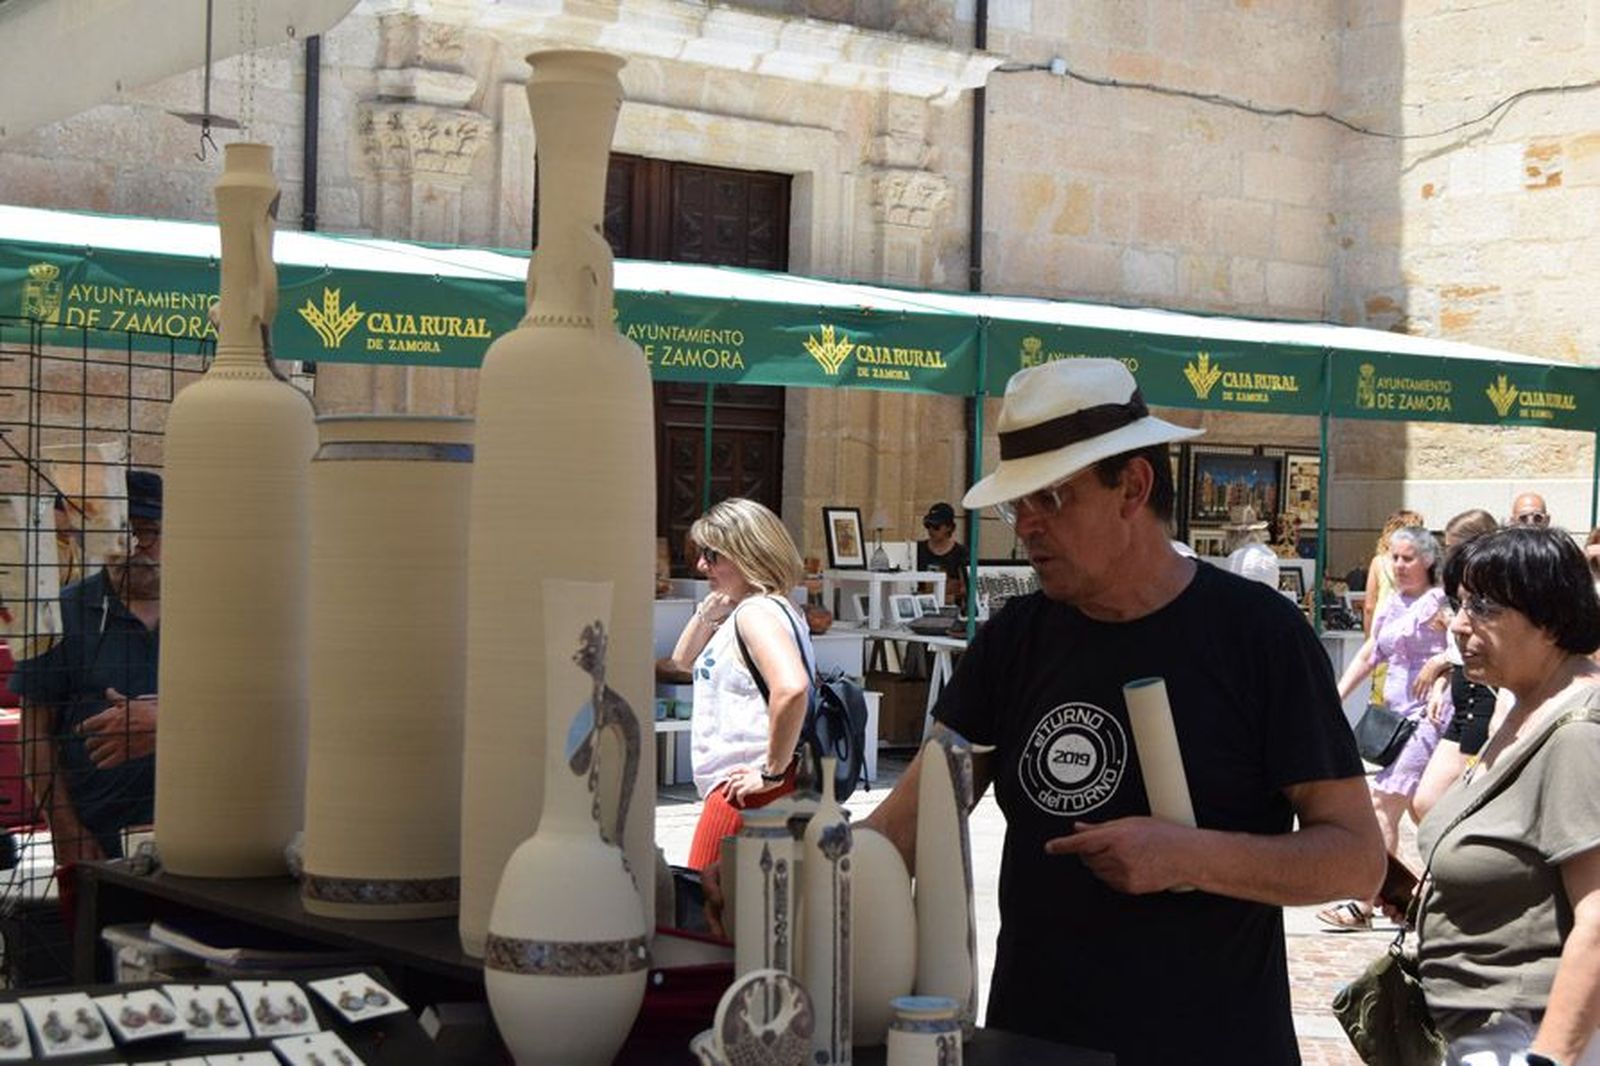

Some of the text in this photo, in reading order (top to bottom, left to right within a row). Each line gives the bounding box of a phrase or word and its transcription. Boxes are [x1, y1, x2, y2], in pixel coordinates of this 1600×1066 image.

[66, 307, 220, 339] DE ZAMORA
[367, 312, 492, 338] CAJA RURAL
[367, 338, 441, 352] DE ZAMORA
[626, 323, 745, 346] AYUNTAMIENTO
[644, 345, 745, 370] E ZAMORA
[1376, 377, 1452, 394] AYUNTAMIENTO
[1377, 393, 1451, 412] DE ZAMORA
[1052, 750, 1091, 767] 2019
